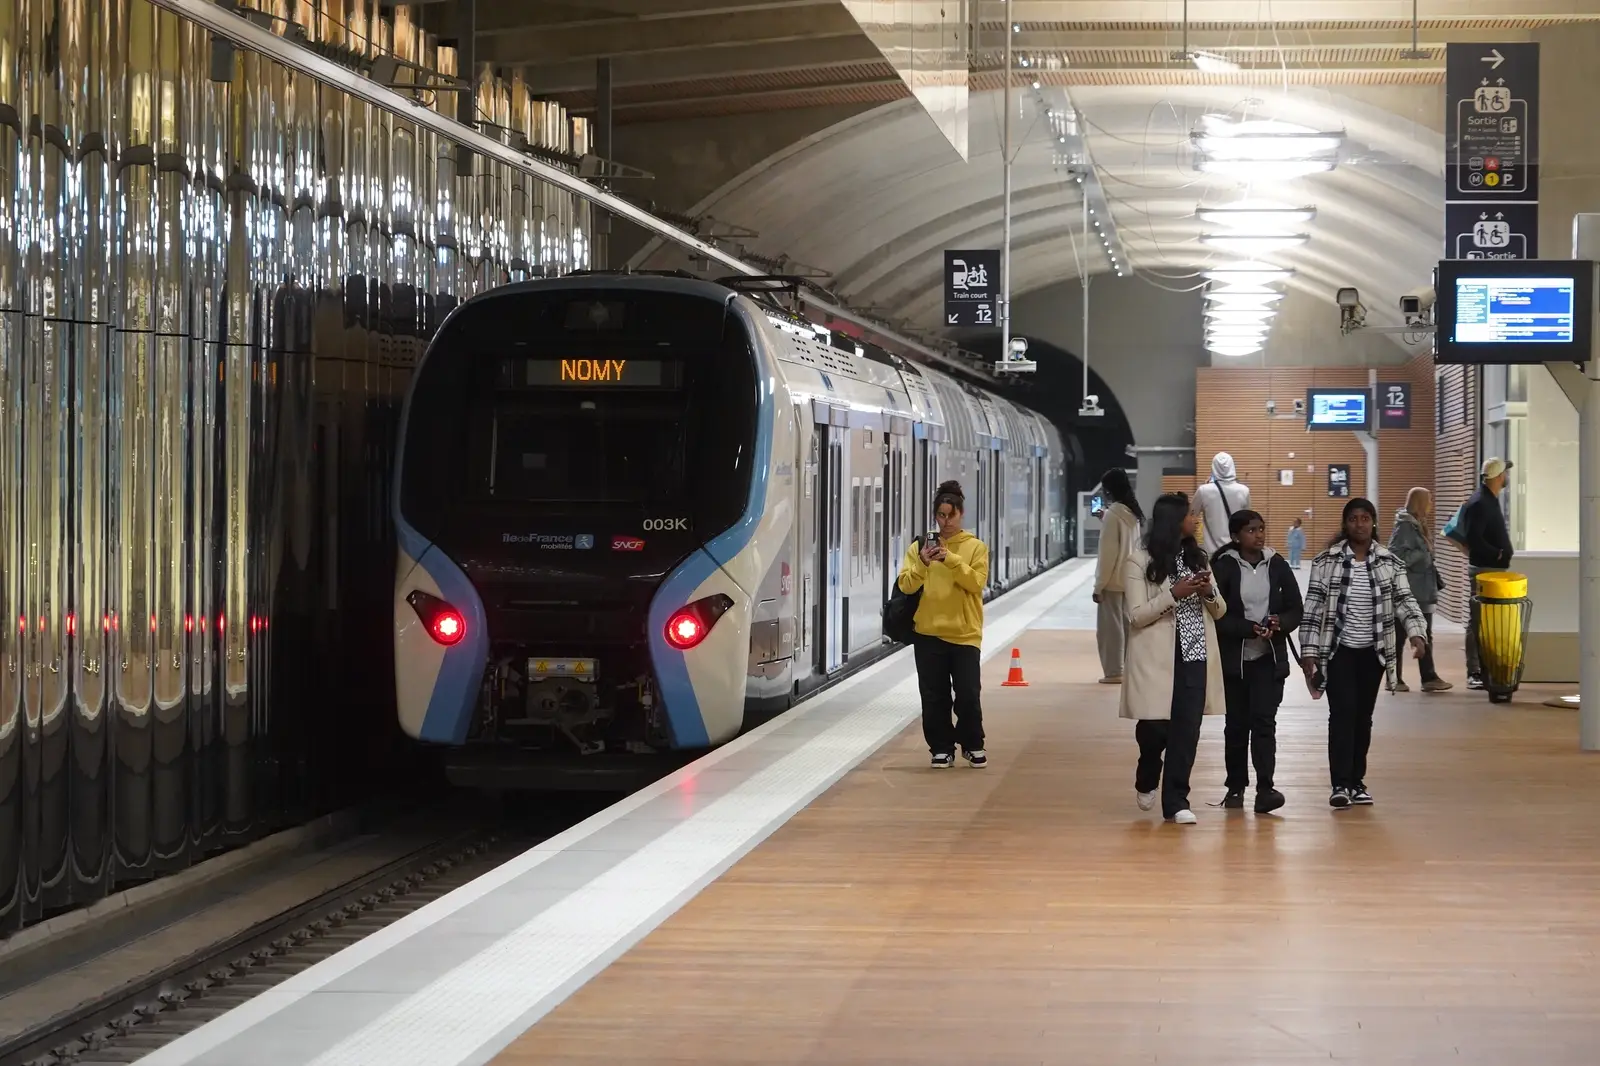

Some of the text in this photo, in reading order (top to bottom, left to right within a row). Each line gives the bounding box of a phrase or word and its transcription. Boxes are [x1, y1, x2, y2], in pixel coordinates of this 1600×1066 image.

[1467, 116, 1497, 125] Sortie
[1472, 175, 1480, 183] M
[1503, 173, 1513, 184] P
[1487, 251, 1517, 259] Sortie
[976, 310, 992, 321] 12
[560, 359, 626, 381] NOMY
[1386, 392, 1405, 405] 12
[642, 517, 688, 532] 003K
[540, 542, 573, 550] mobilités
[611, 539, 645, 549] SNCF
